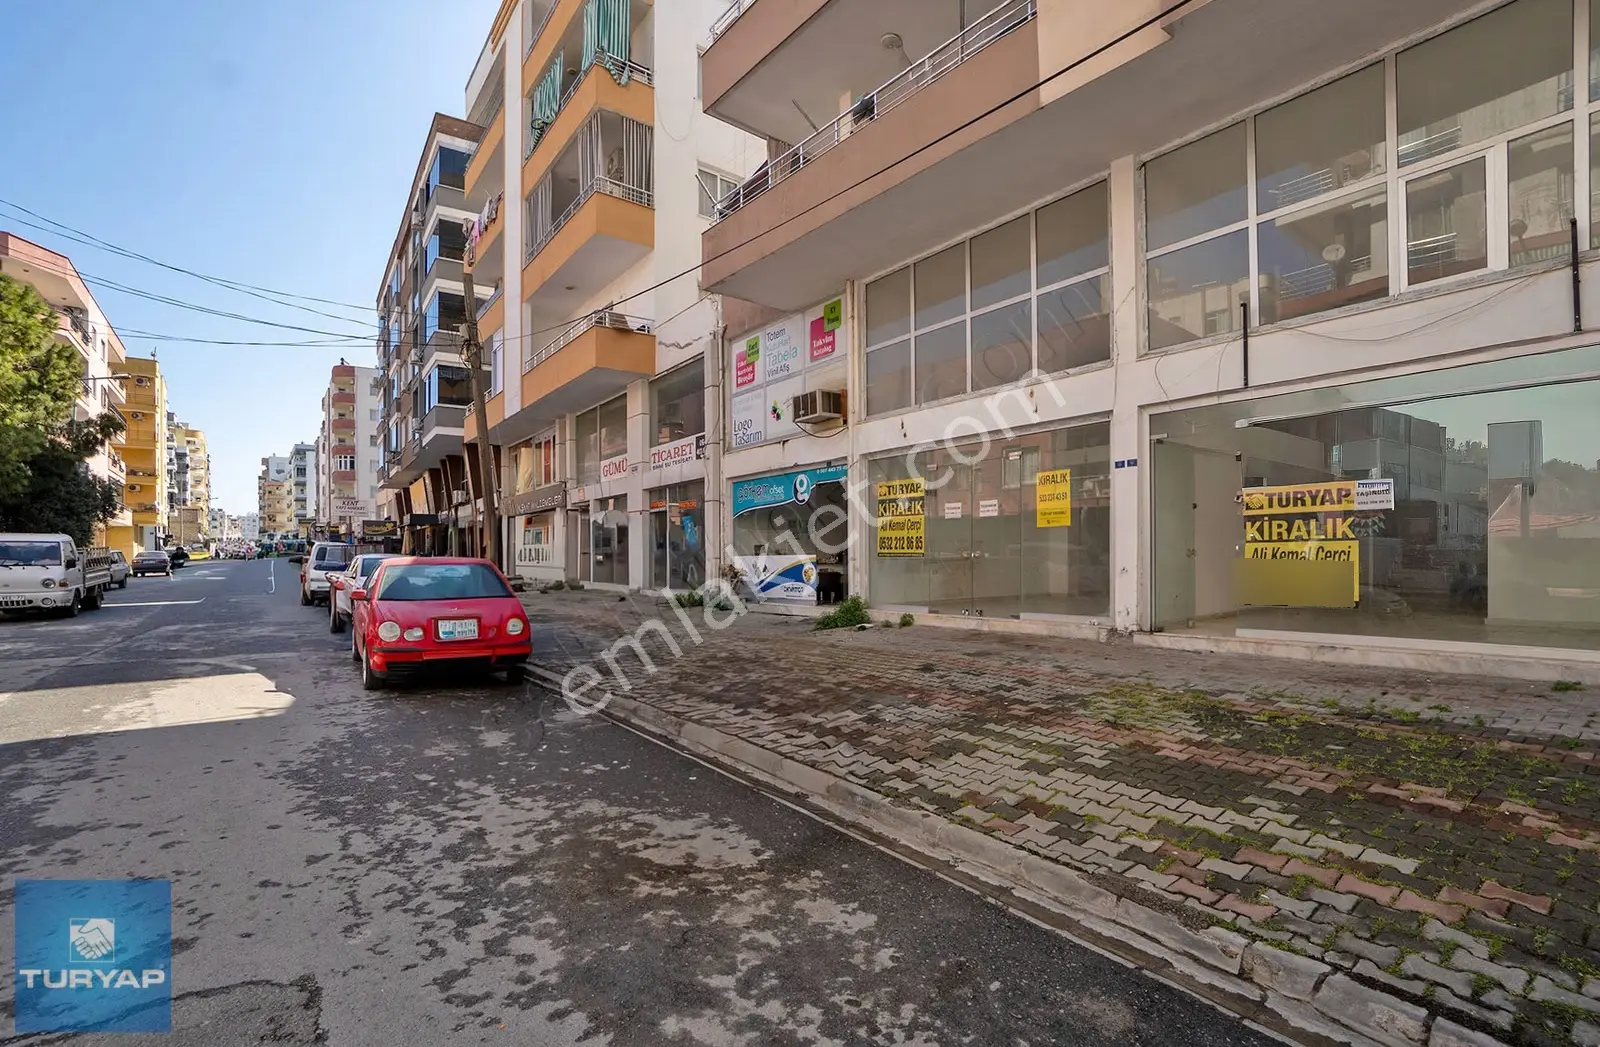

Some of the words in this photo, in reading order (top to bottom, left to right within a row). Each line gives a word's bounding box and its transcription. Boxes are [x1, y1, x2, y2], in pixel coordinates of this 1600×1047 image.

[767, 328, 786, 342] Totem
[767, 346, 798, 367] Tabela
[734, 419, 753, 436] Logo
[734, 430, 763, 446] Tasarım
[652, 443, 694, 464] TİCARET
[602, 457, 628, 478] GÜMÜ
[1038, 473, 1068, 486] KİRALIK
[887, 482, 921, 496] TURYAP
[1264, 488, 1352, 509] TURYAP
[878, 499, 924, 516] KİRALIK
[880, 519, 888, 531] Ali
[888, 519, 906, 531] Kemal
[906, 518, 922, 534] Çerçi
[1245, 516, 1356, 541] KİRALIK
[879, 536, 894, 550] 0532
[894, 536, 905, 550] 212
[906, 536, 914, 550] 86
[1252, 547, 1268, 559] Ali
[1271, 547, 1312, 561] Kemal
